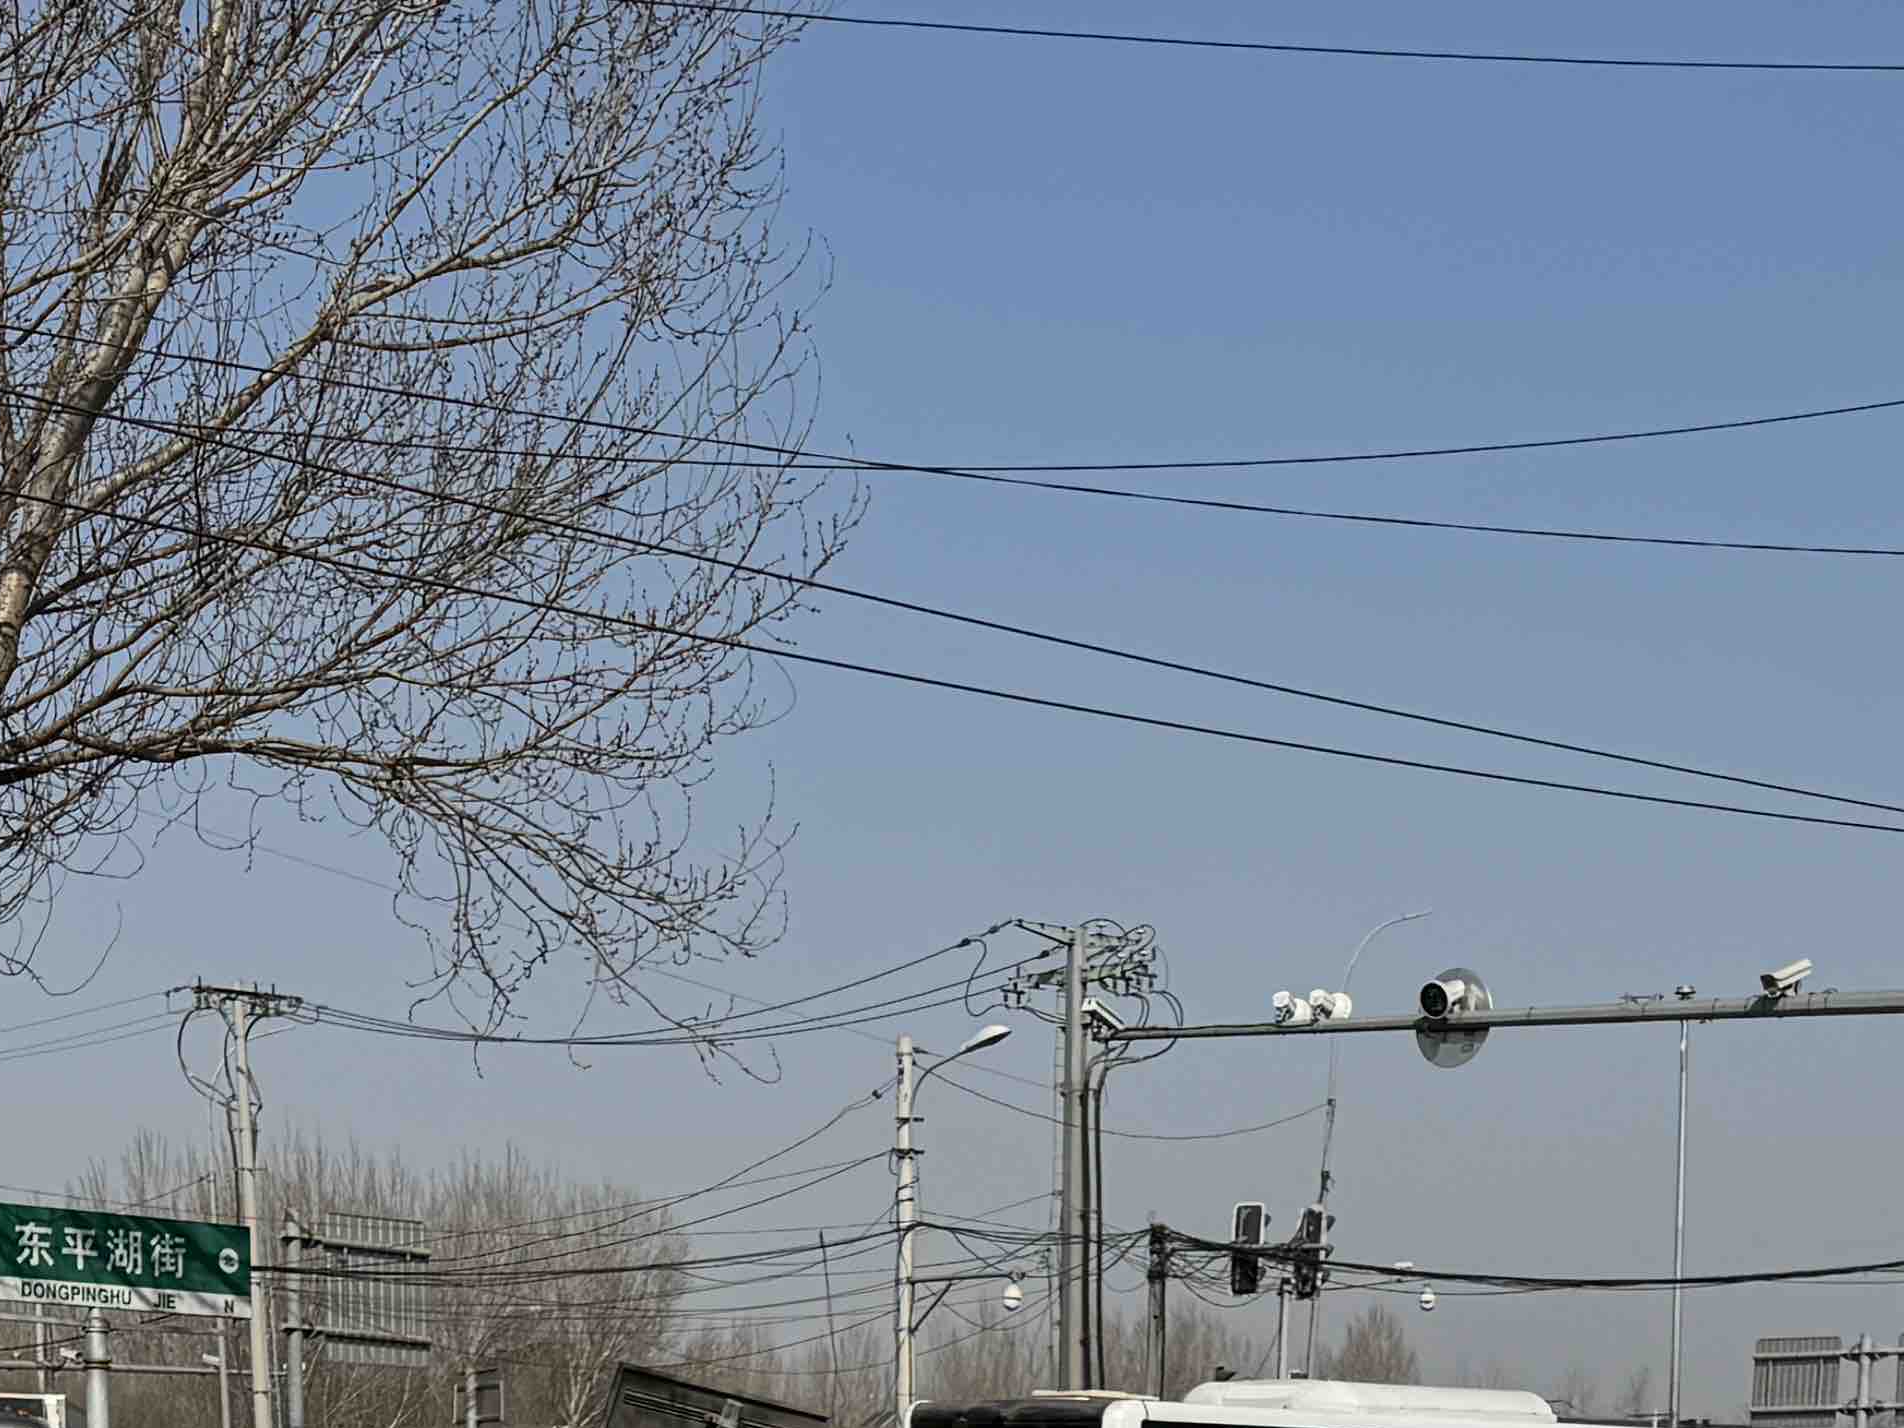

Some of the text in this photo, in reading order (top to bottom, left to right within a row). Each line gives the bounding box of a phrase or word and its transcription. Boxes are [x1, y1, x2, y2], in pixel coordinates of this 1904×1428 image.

[14, 1221, 186, 1279] 东平湖街
[20, 1281, 133, 1306] DONGPINGHU
[152, 1292, 177, 1310] JIE
[223, 1299, 235, 1314] N
